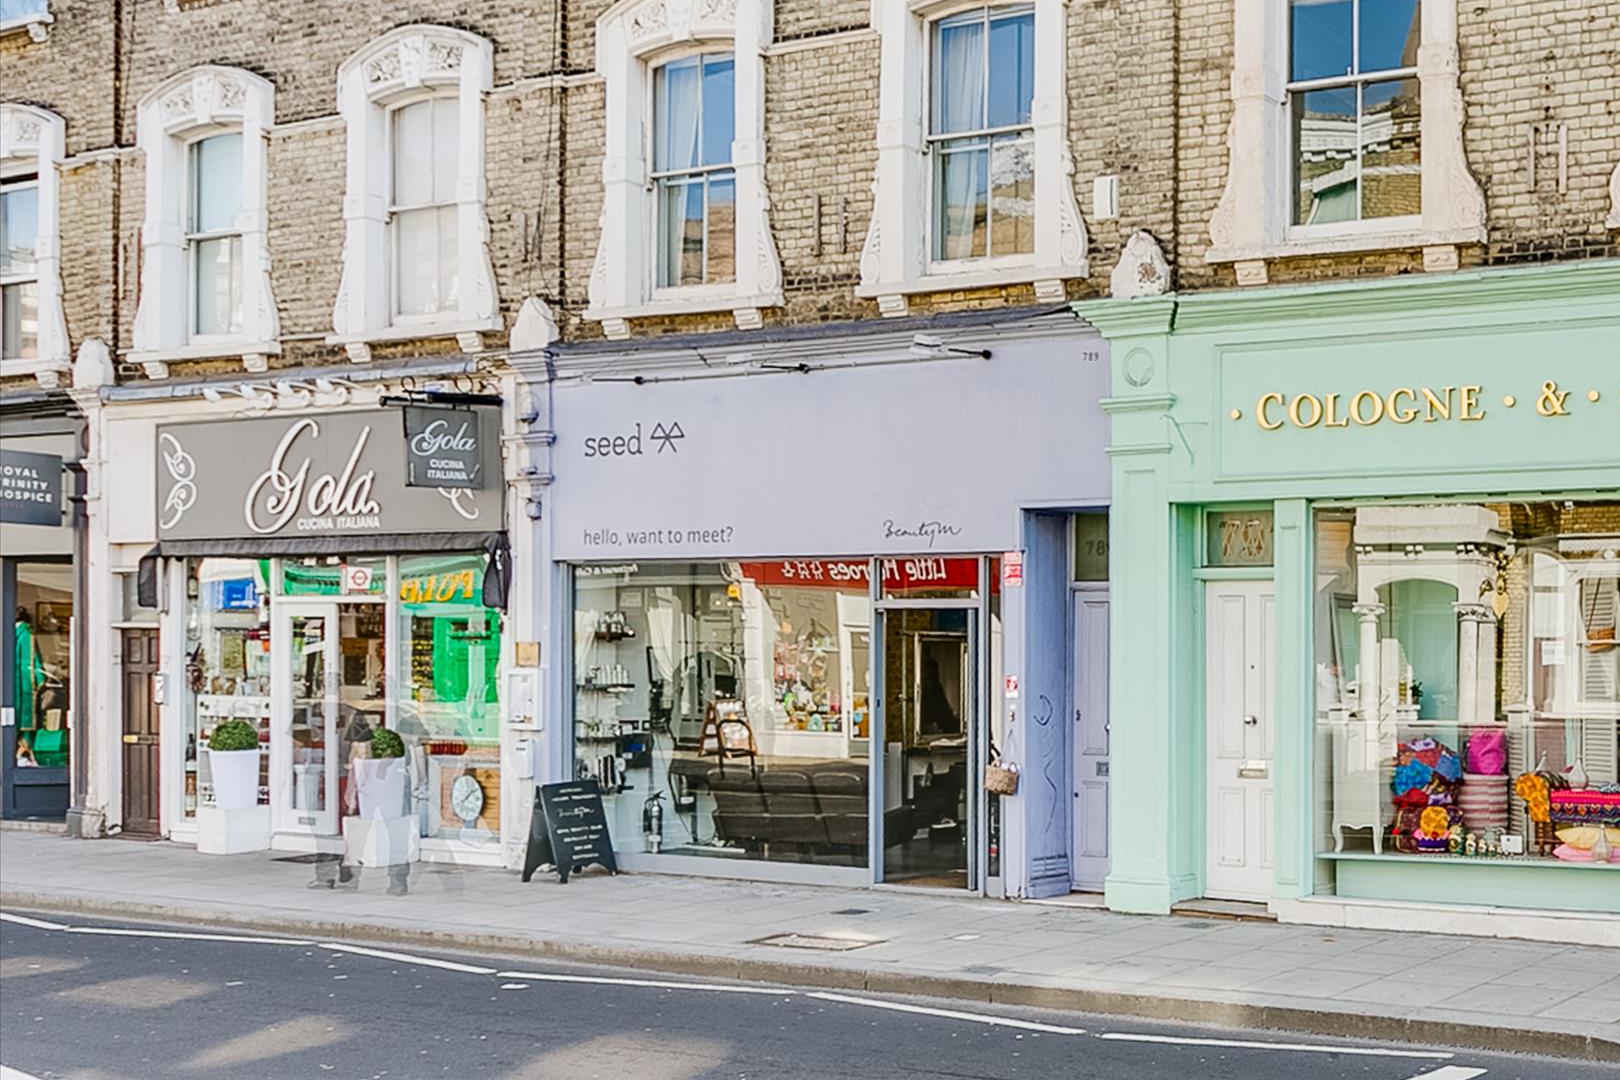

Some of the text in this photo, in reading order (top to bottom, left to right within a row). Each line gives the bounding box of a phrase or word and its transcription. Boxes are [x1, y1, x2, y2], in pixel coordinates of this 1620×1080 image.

[1082, 351, 1100, 361] 789
[1254, 384, 1486, 431] COLOGNE
[1534, 379, 1571, 417] &
[411, 420, 477, 457] Gola
[584, 423, 643, 457] seed
[0, 466, 39, 478] OYAL
[429, 458, 465, 469] CUCINA
[244, 418, 382, 535] Gola
[427, 469, 468, 480] ITALIANA
[297, 516, 381, 531] CUCINA ITALIANA
[583, 526, 734, 547] hello, want to meet?
[1085, 540, 1110, 557] 78
